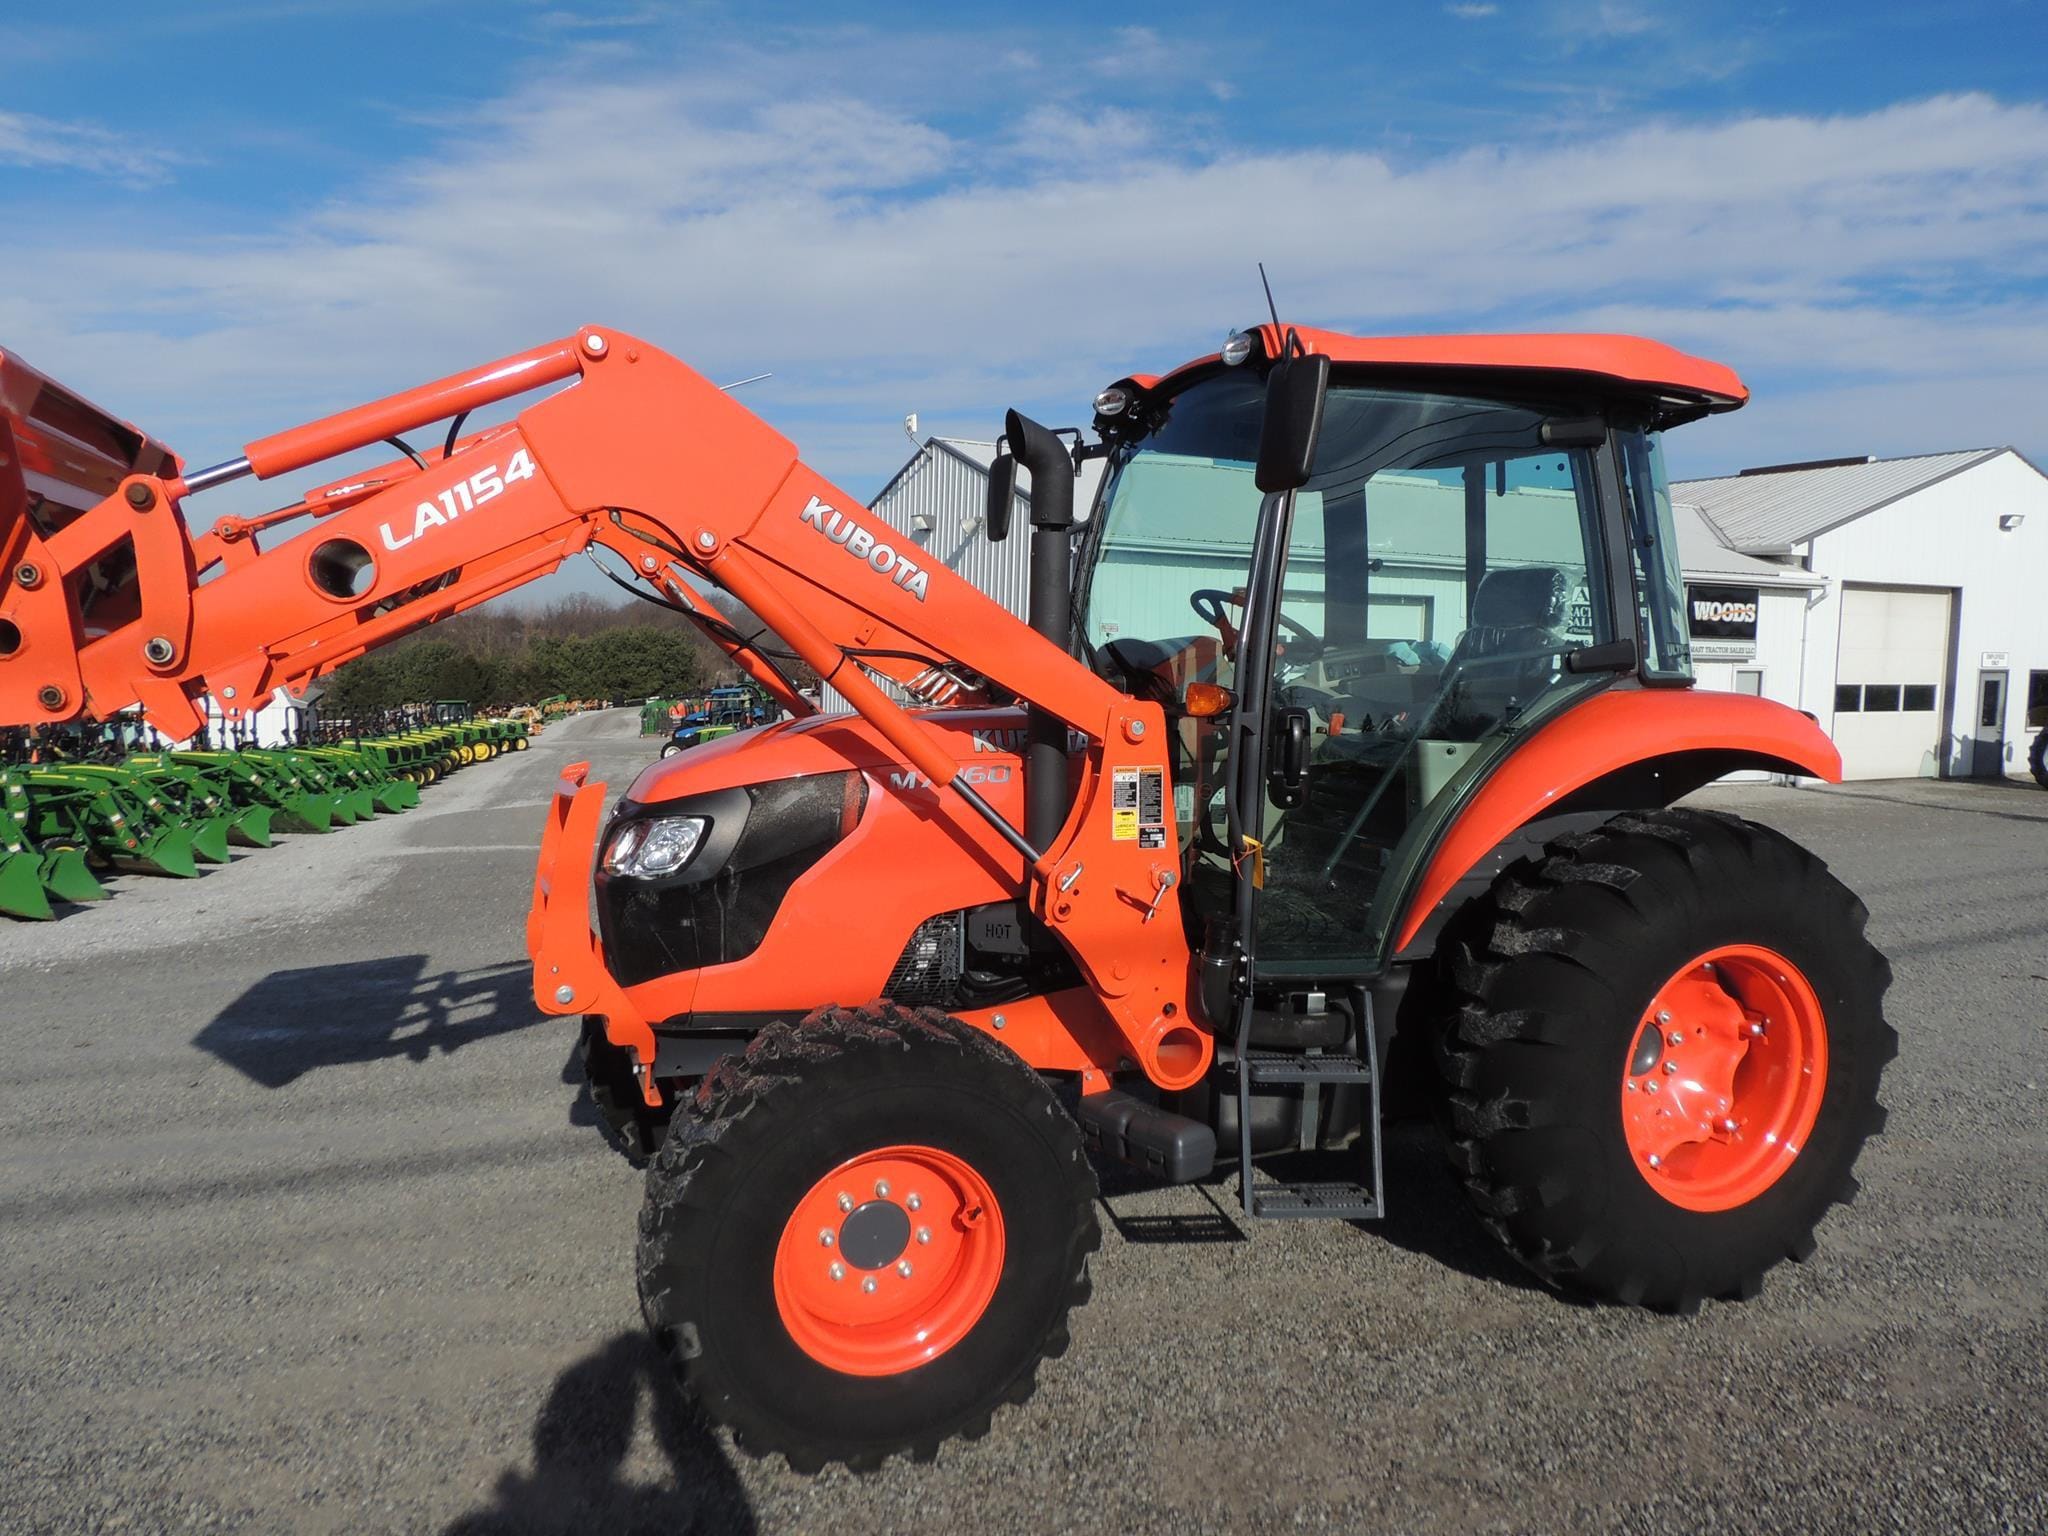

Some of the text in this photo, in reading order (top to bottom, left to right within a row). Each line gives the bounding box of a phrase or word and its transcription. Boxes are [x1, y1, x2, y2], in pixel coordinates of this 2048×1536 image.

[379, 448, 536, 551] LA1154
[799, 494, 930, 603] KUBOTA
[1693, 601, 1756, 623] WOODS
[1705, 646, 1729, 654] TRACTOR
[890, 765, 1011, 790] M60
[985, 923, 1012, 939] HOT
